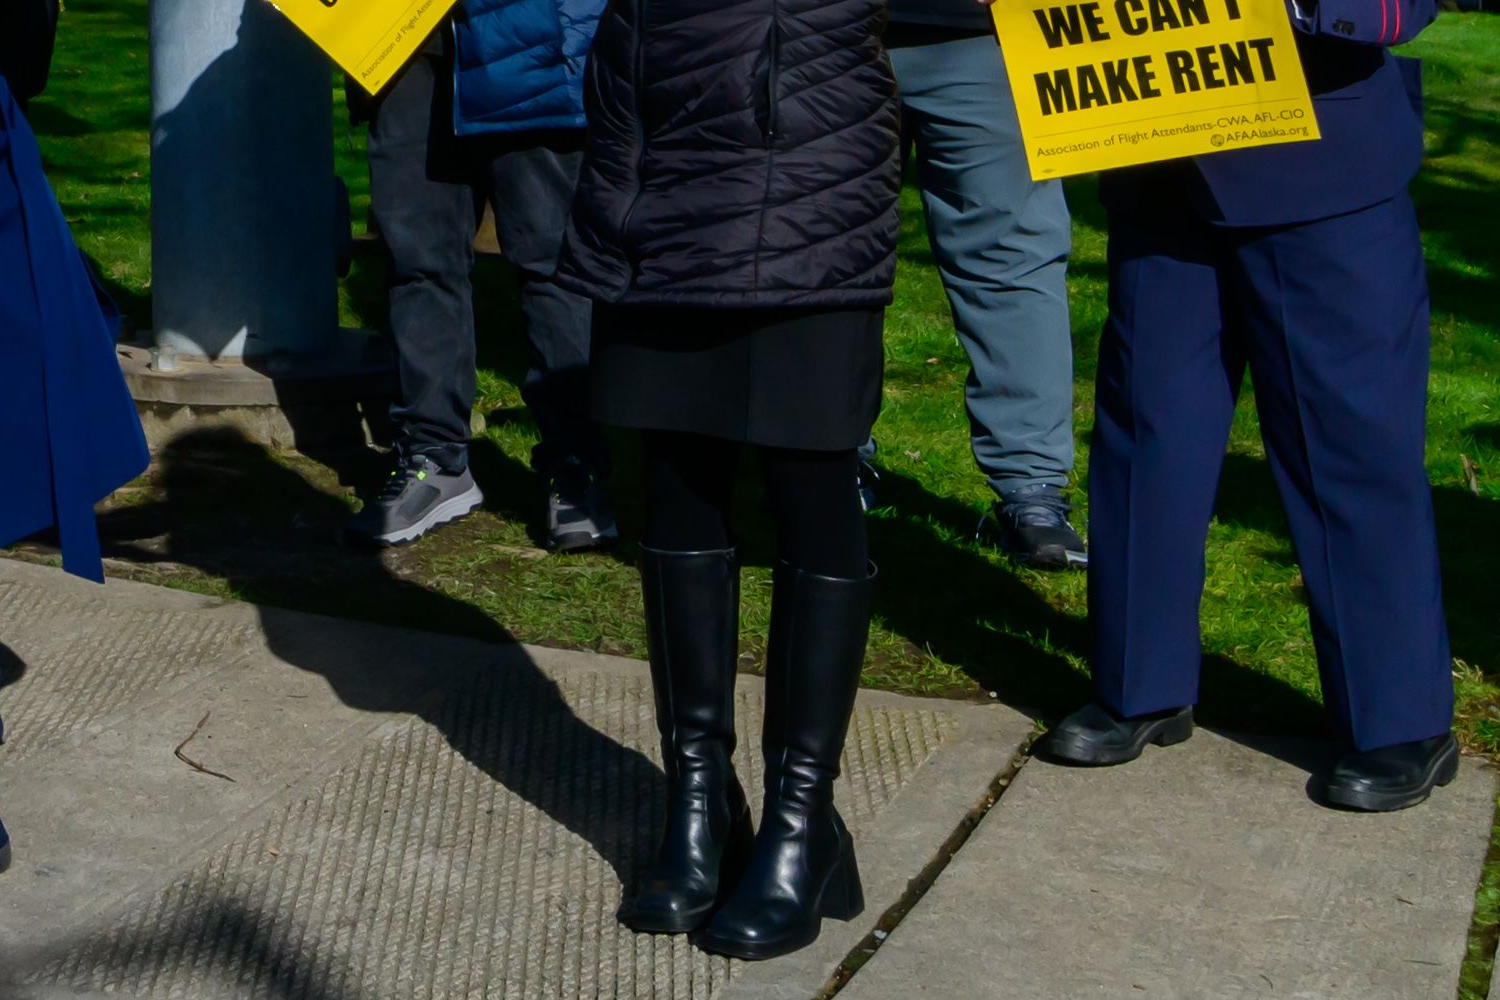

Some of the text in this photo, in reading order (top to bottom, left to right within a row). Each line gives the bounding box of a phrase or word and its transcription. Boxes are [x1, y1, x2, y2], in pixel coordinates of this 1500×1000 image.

[361, 42, 396, 79] Association
[395, 32, 403, 43] of
[401, 14, 419, 35] Flight
[1033, 2, 1111, 49] WE
[1033, 37, 1277, 116] MAKE RENT
[1037, 139, 1100, 158] Association
[1103, 135, 1116, 147] of
[1118, 131, 1149, 146] Flight
[1253, 107, 1304, 123] AFL-CIO
[1226, 125, 1309, 143] AFAAlaska.org
